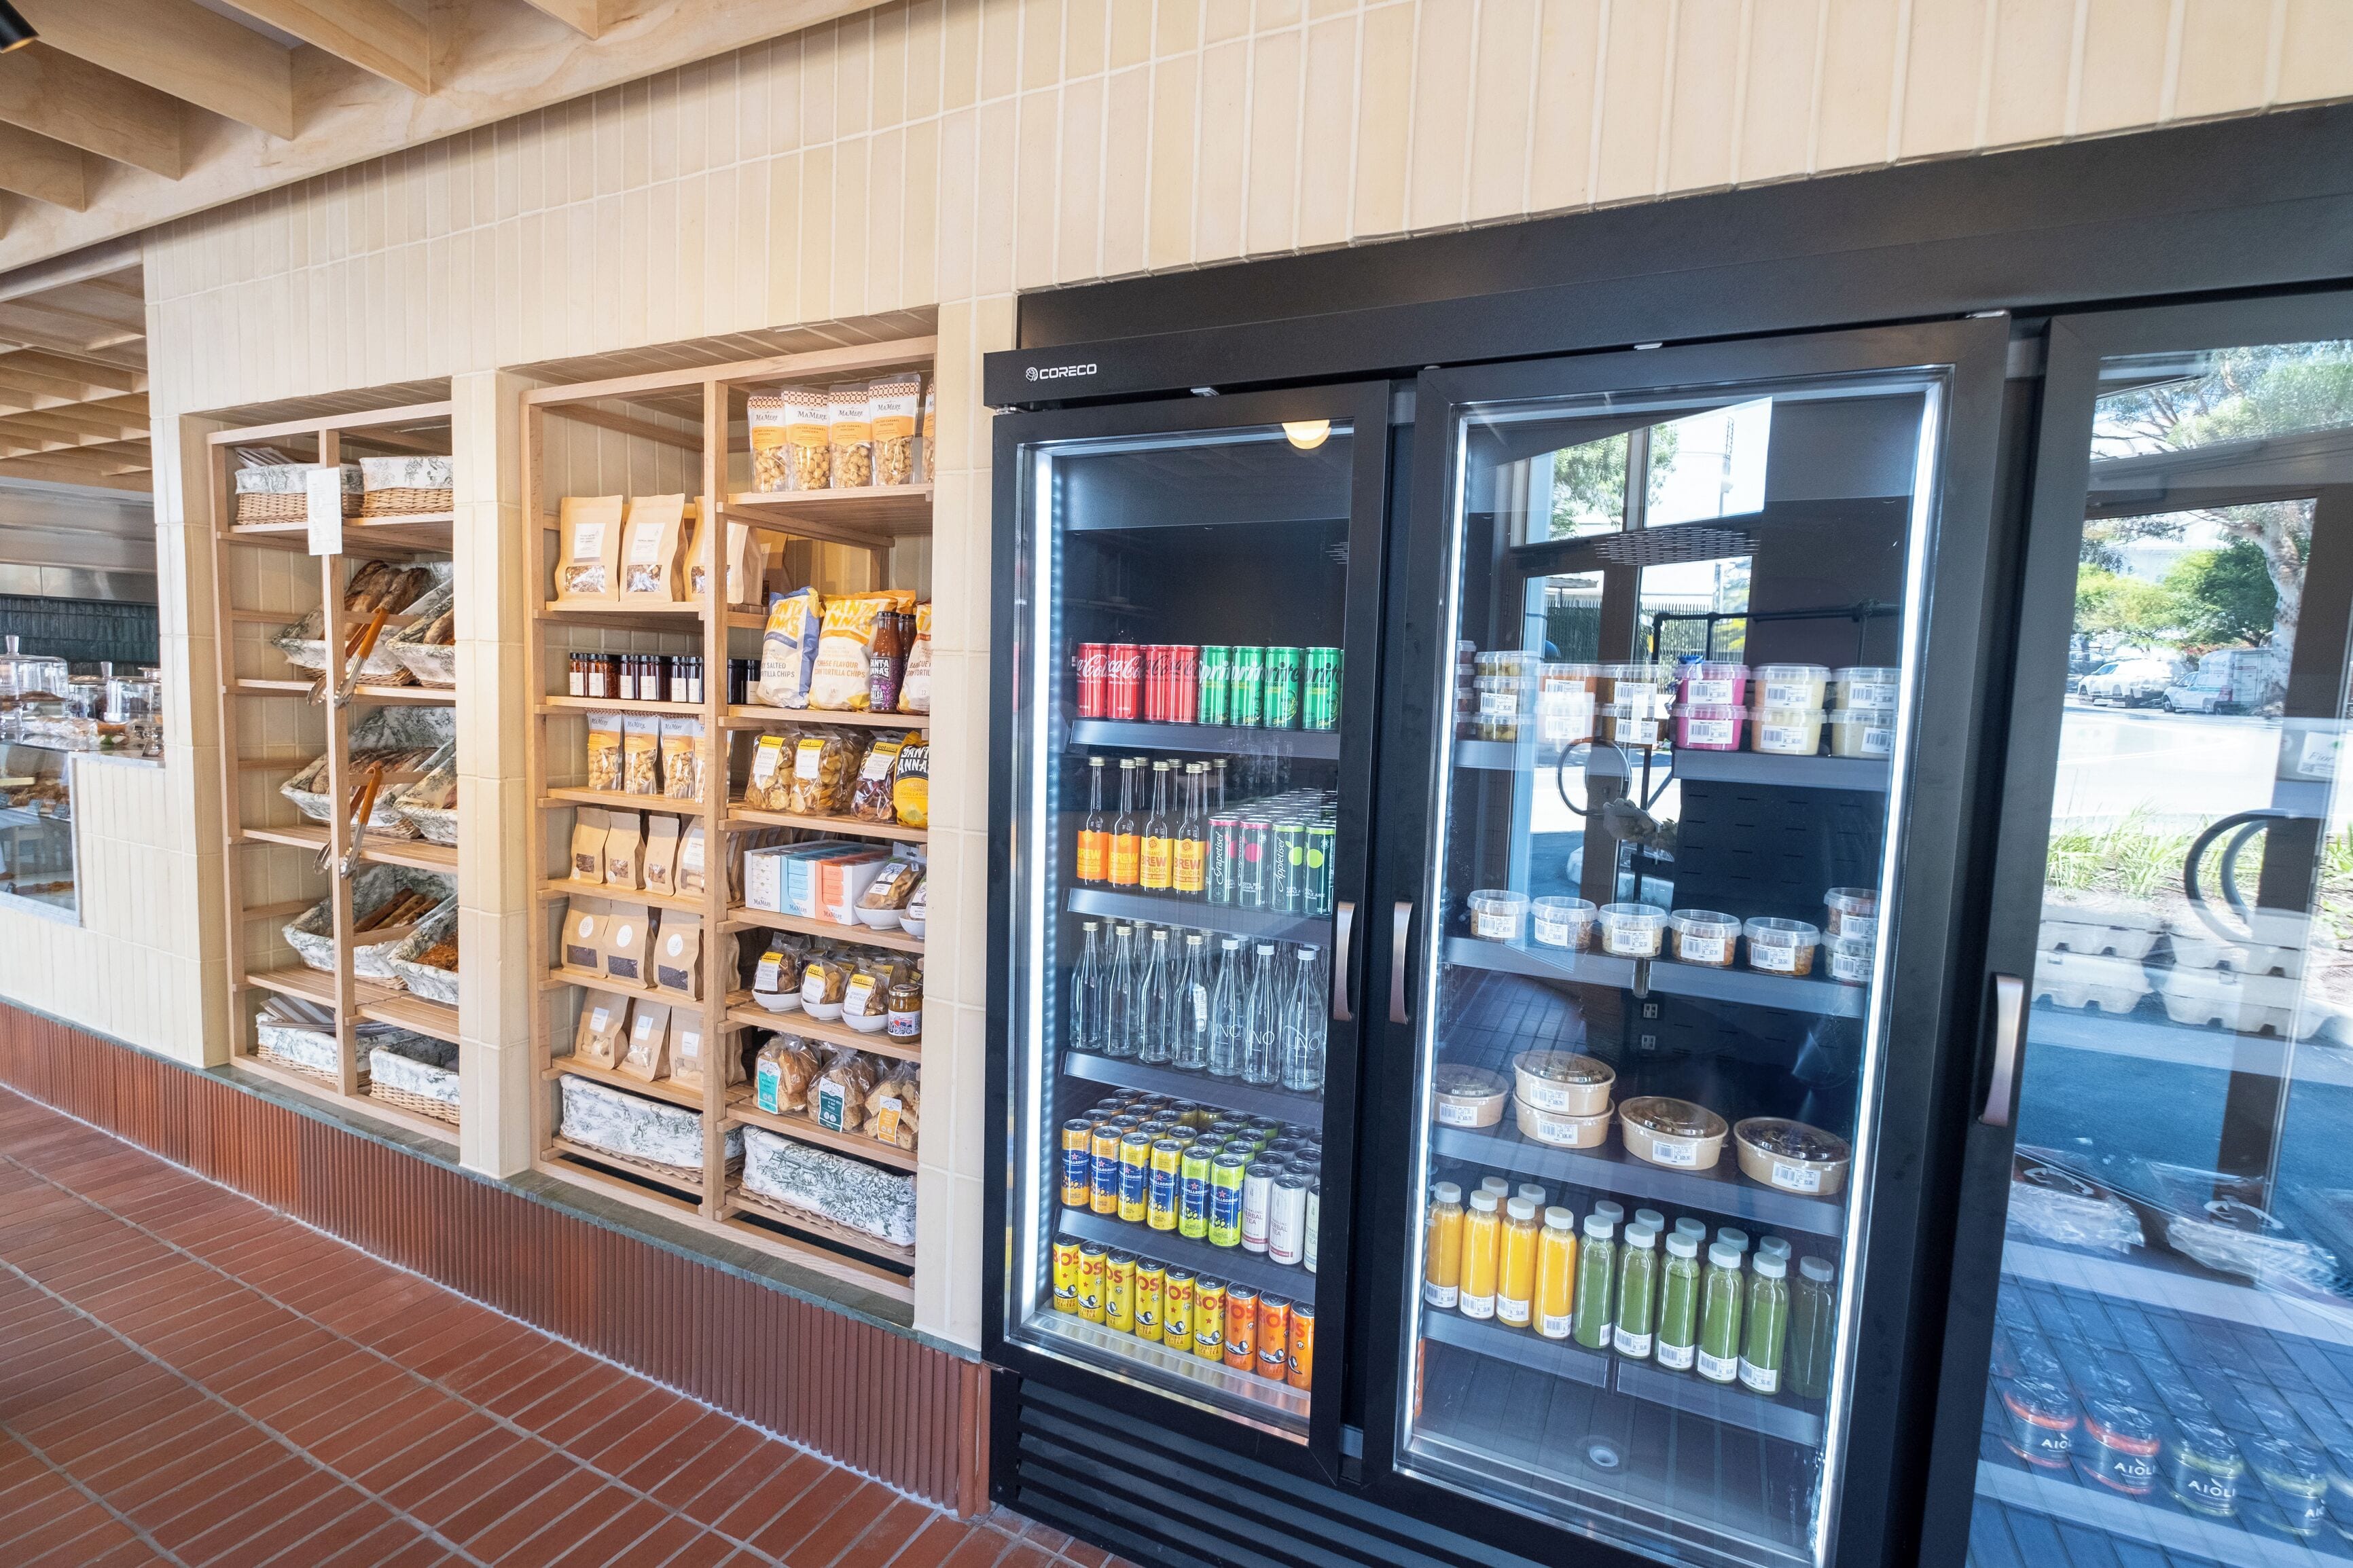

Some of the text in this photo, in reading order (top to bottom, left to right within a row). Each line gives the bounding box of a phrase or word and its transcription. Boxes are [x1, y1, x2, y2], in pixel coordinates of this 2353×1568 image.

[1040, 364, 1097, 380] CORECO
[1111, 852, 1138, 864] BREW
[1141, 854, 1167, 867] BREW
[1174, 857, 1201, 870] BREW
[1213, 831, 1223, 886] Grapetiser
[1274, 837, 1285, 892] Appletiser
[1246, 1217, 1257, 1225] TEA
[1272, 1222, 1288, 1233] ERBAL
[1272, 1228, 1281, 1237] TEA
[1081, 1262, 1103, 1275] OS
[1136, 1275, 1160, 1292] OS
[1196, 1291, 1226, 1311] BOS
